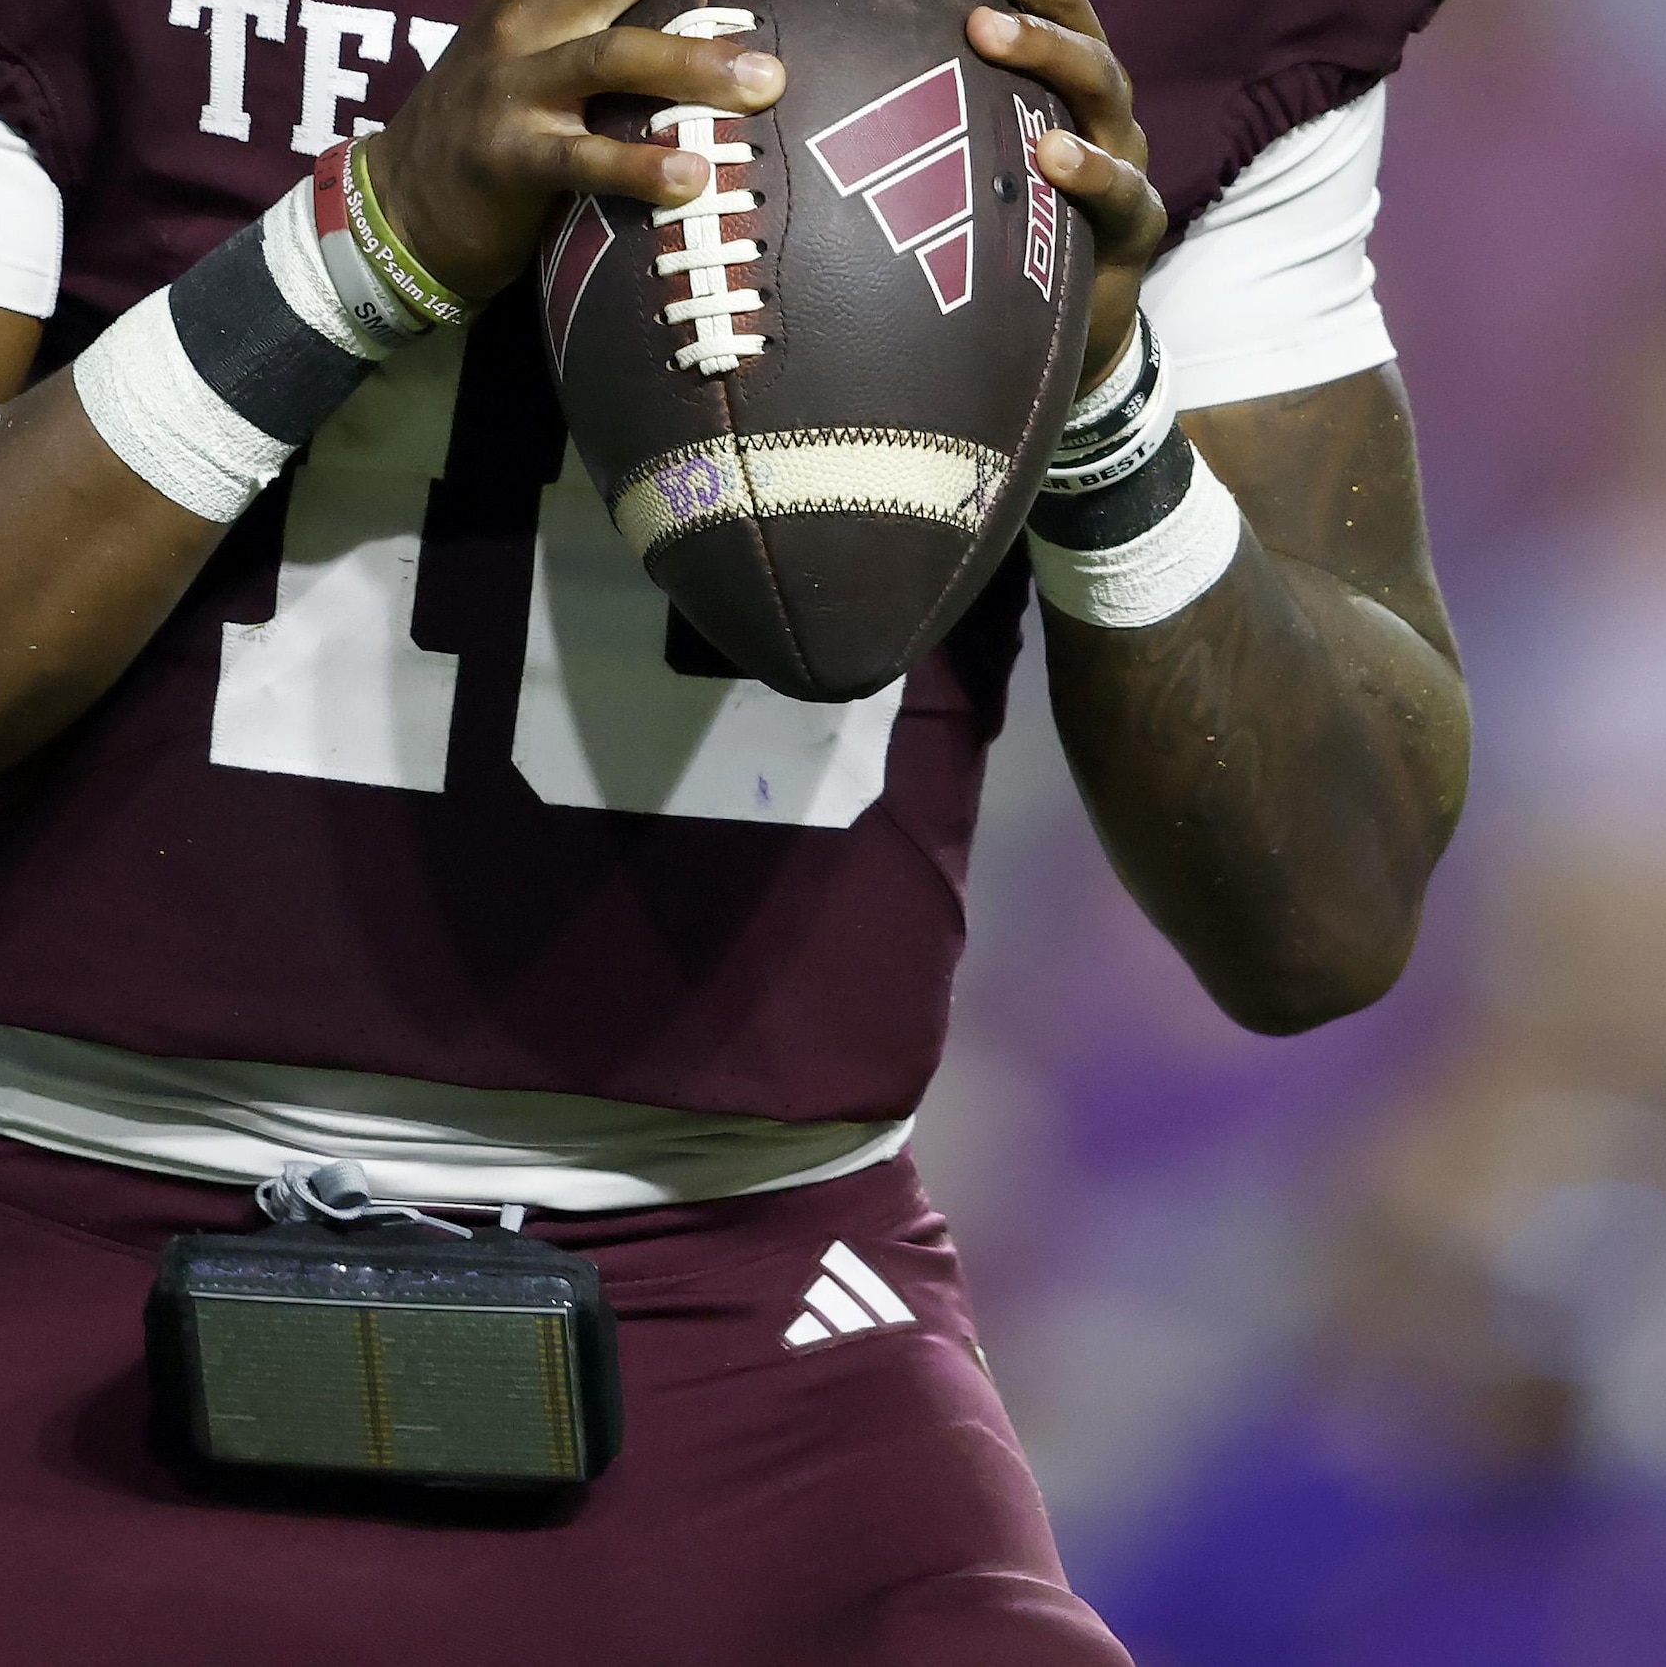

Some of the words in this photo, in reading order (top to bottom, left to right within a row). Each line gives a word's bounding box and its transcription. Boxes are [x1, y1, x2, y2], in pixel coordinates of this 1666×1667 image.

[347, 190, 380, 253] Strong
[375, 245, 425, 302] Psalm
[1078, 441, 1156, 487] BEST.
